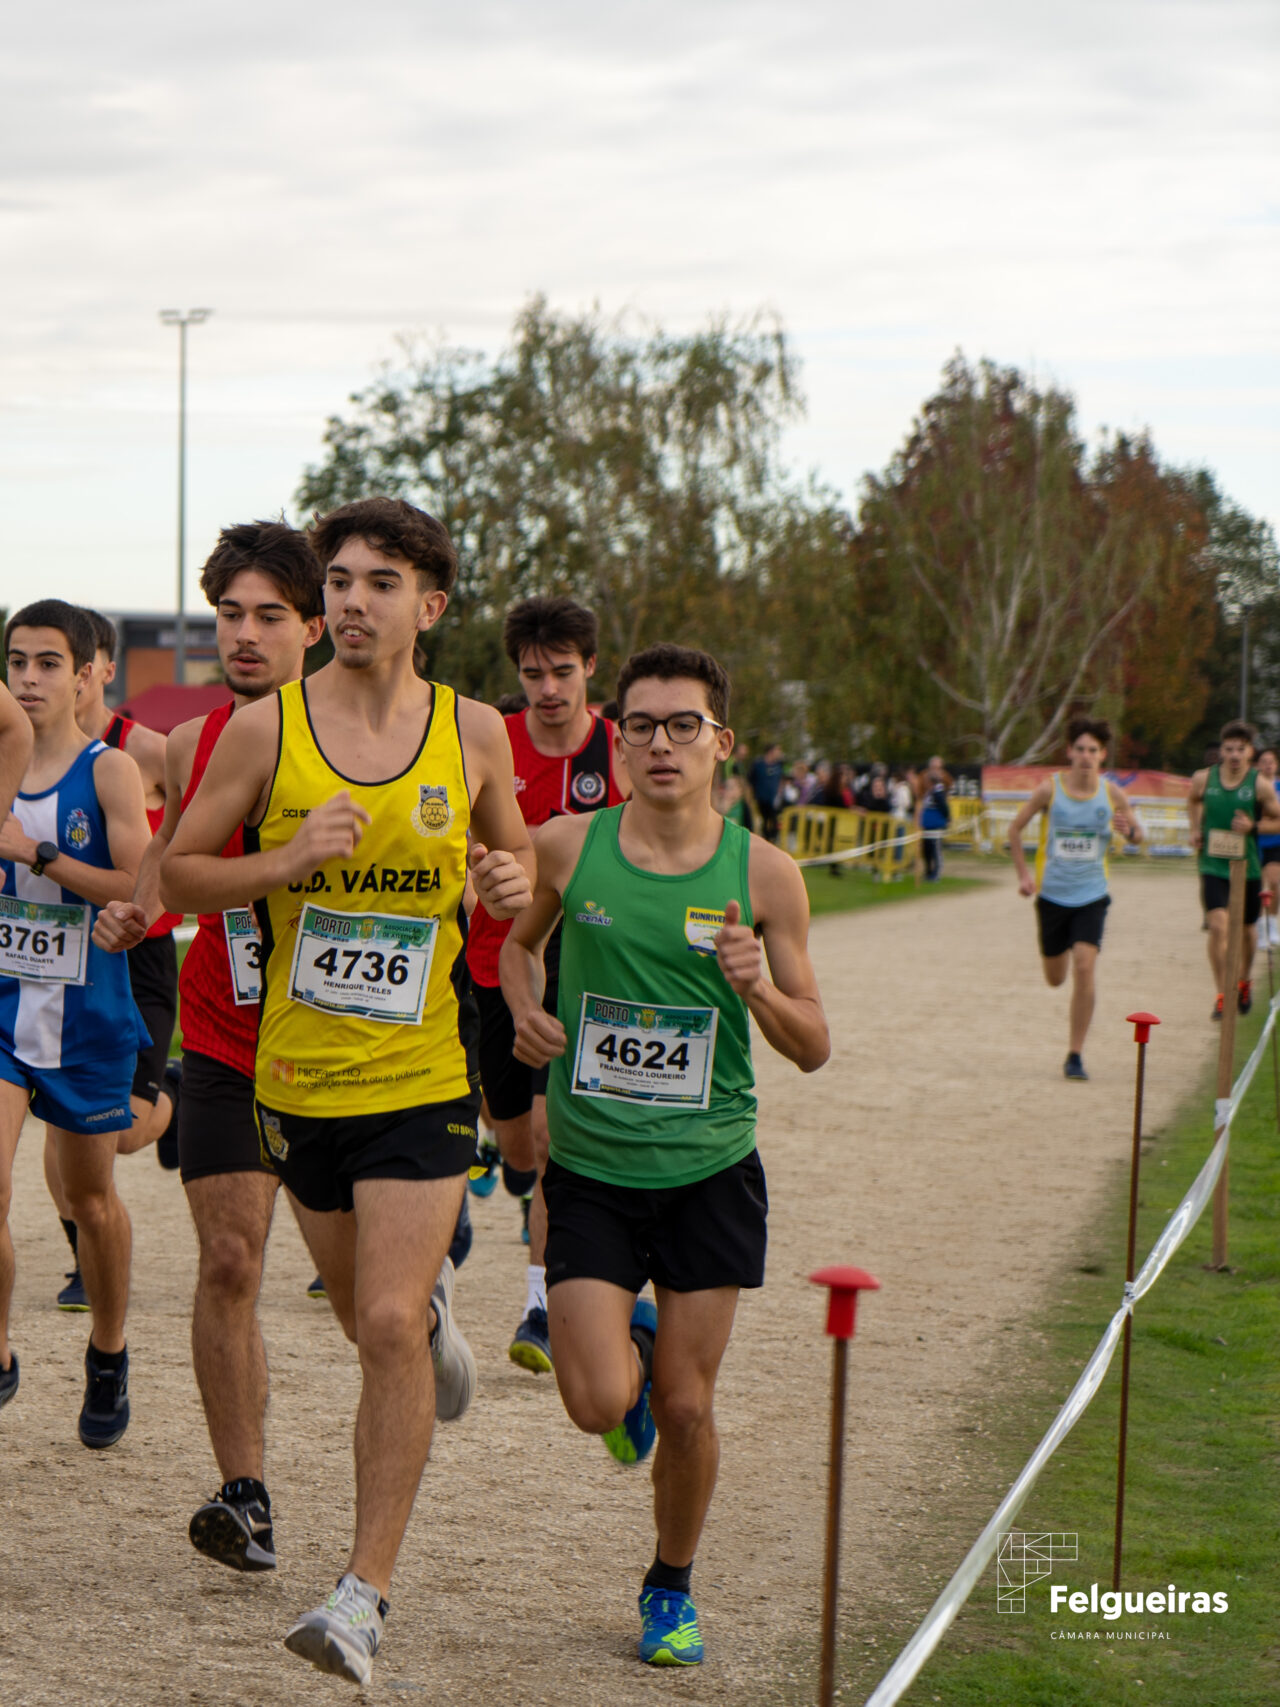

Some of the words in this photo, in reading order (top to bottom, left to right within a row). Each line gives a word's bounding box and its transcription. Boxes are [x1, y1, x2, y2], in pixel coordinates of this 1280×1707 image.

[341, 863, 441, 893] VÁRZEA
[314, 914, 351, 936] PORTO
[5, 952, 28, 961] RAFAEL
[313, 946, 410, 986] 4736
[323, 980, 365, 991] HENRIQUE
[366, 985, 392, 995] TELES
[595, 1002, 629, 1023] PORTO
[595, 1033, 690, 1071] 4624
[600, 1063, 644, 1077] FRANCISCO
[646, 1071, 687, 1081] LOUREIRO
